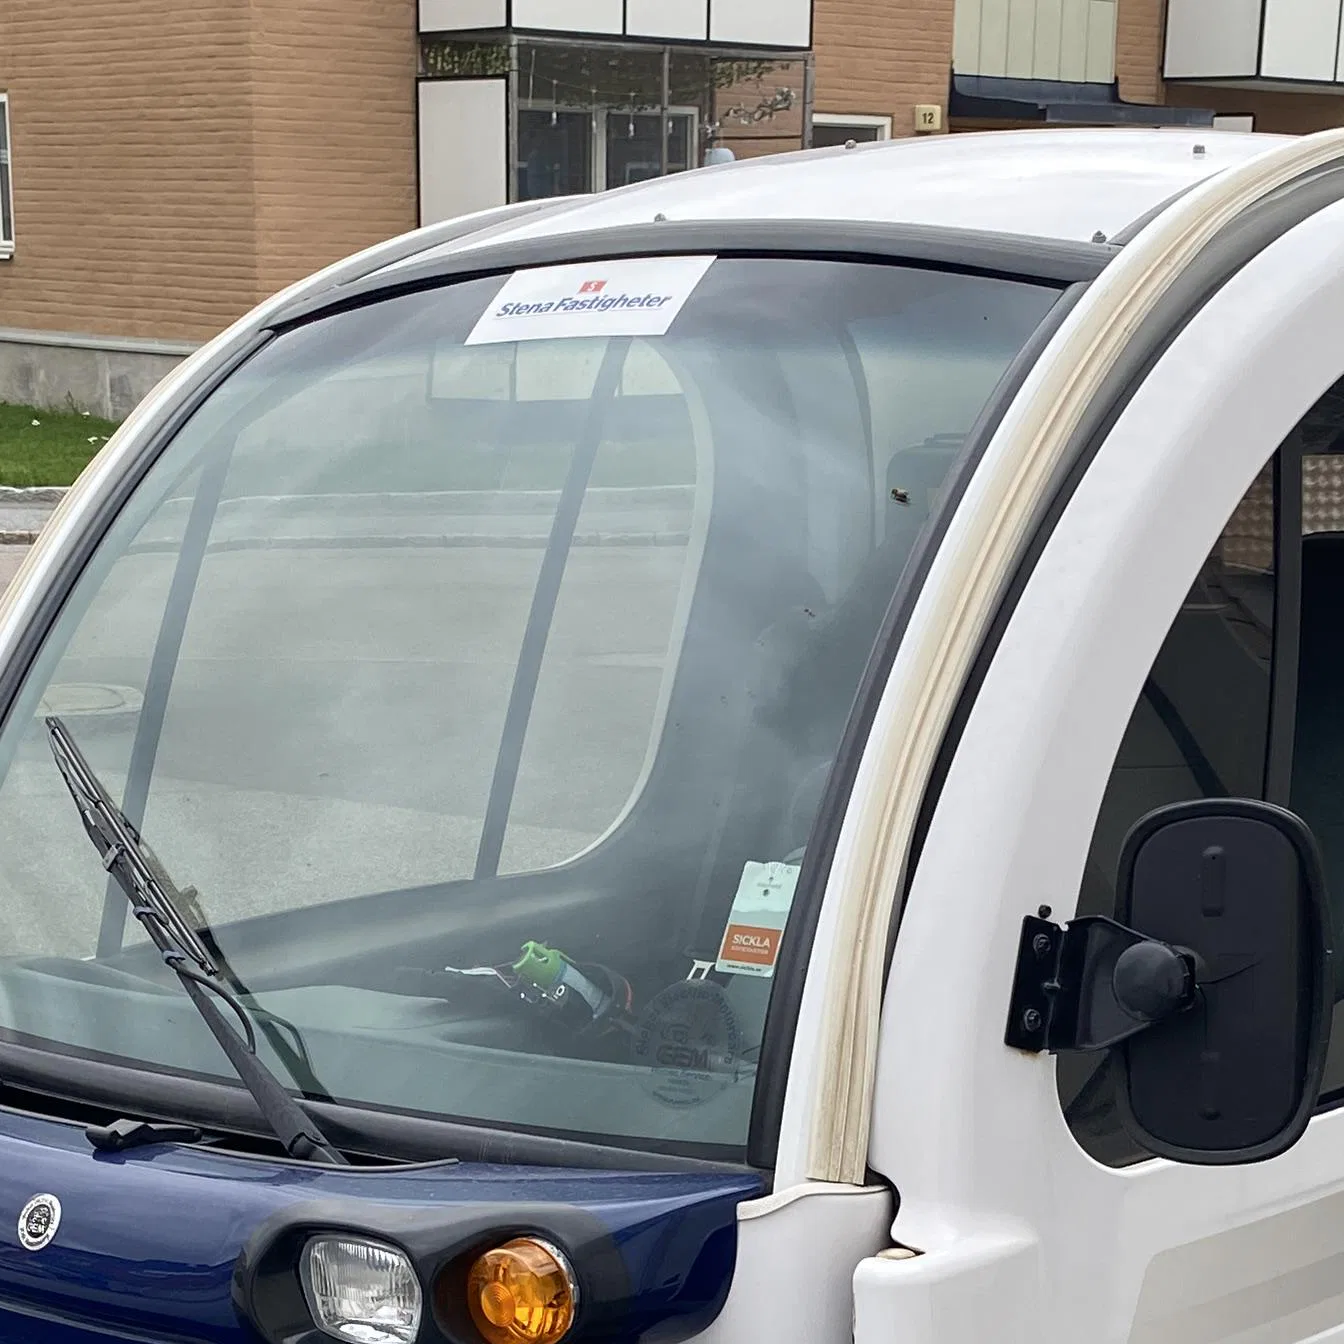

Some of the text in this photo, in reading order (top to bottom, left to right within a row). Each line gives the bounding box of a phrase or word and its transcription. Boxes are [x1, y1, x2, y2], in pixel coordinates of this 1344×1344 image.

[922, 112, 934, 124] 12
[496, 293, 672, 317] Stena Fastigheter
[732, 934, 770, 947] SICKLA
